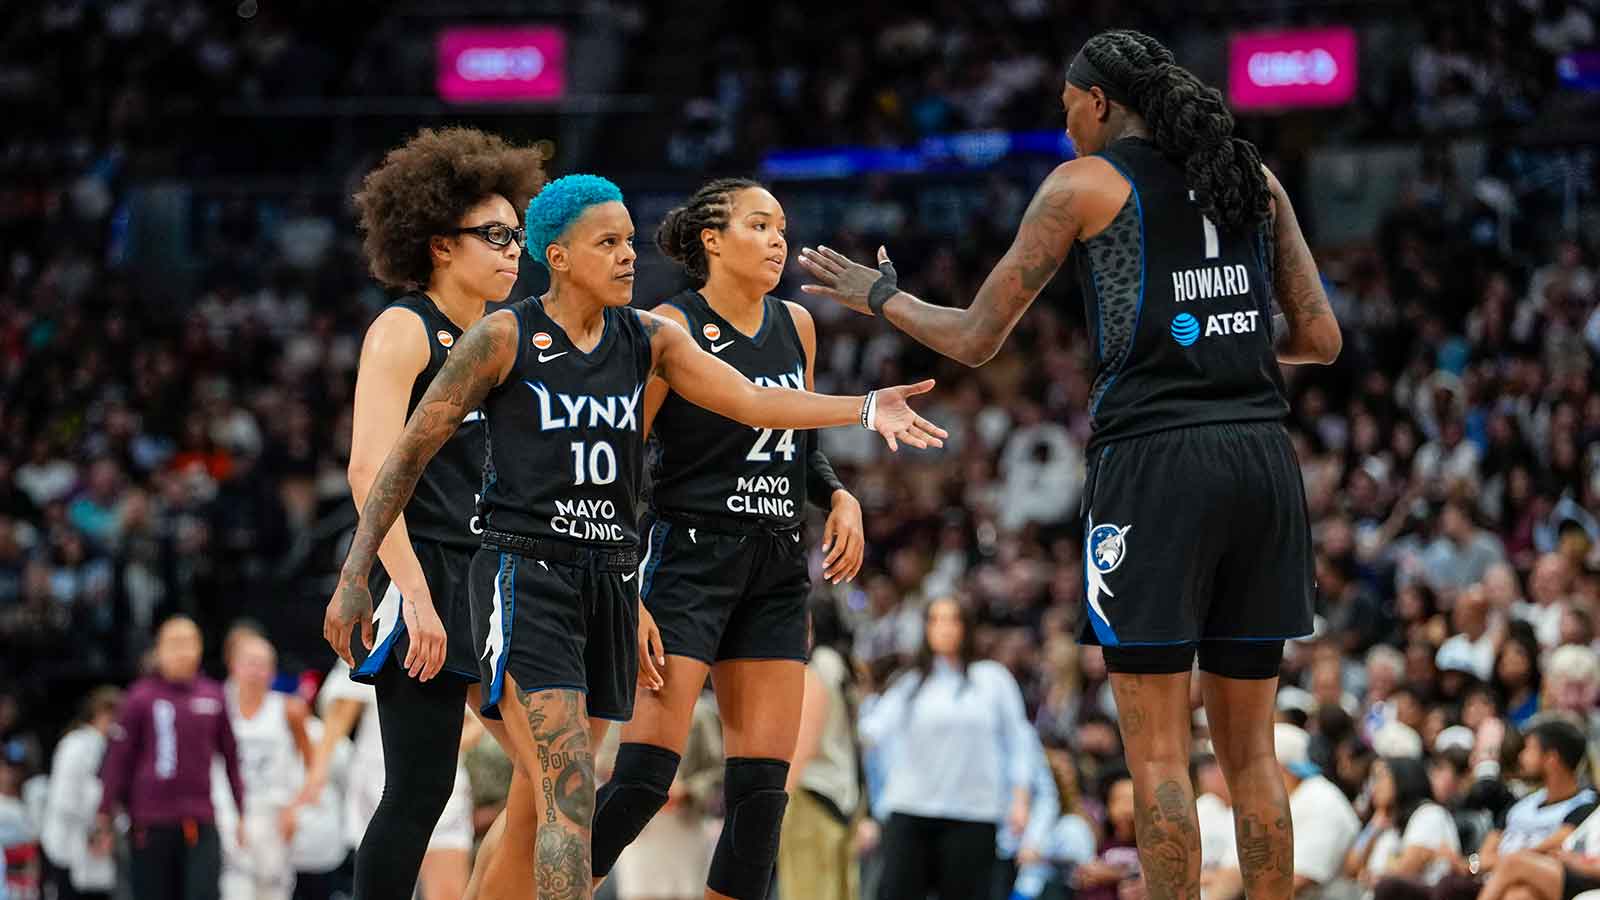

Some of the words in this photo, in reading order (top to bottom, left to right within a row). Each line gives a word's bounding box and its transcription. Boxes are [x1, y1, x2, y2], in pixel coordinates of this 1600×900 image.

[1172, 264, 1250, 302] HOWARD
[1204, 310, 1259, 337] AT&T
[525, 381, 645, 432] LYNX
[745, 427, 796, 461] 24
[570, 440, 617, 486] 10
[736, 475, 790, 496] MAYO
[554, 499, 616, 520] MAYO
[726, 495, 795, 518] CLINIC
[550, 516, 625, 542] CLINIC
